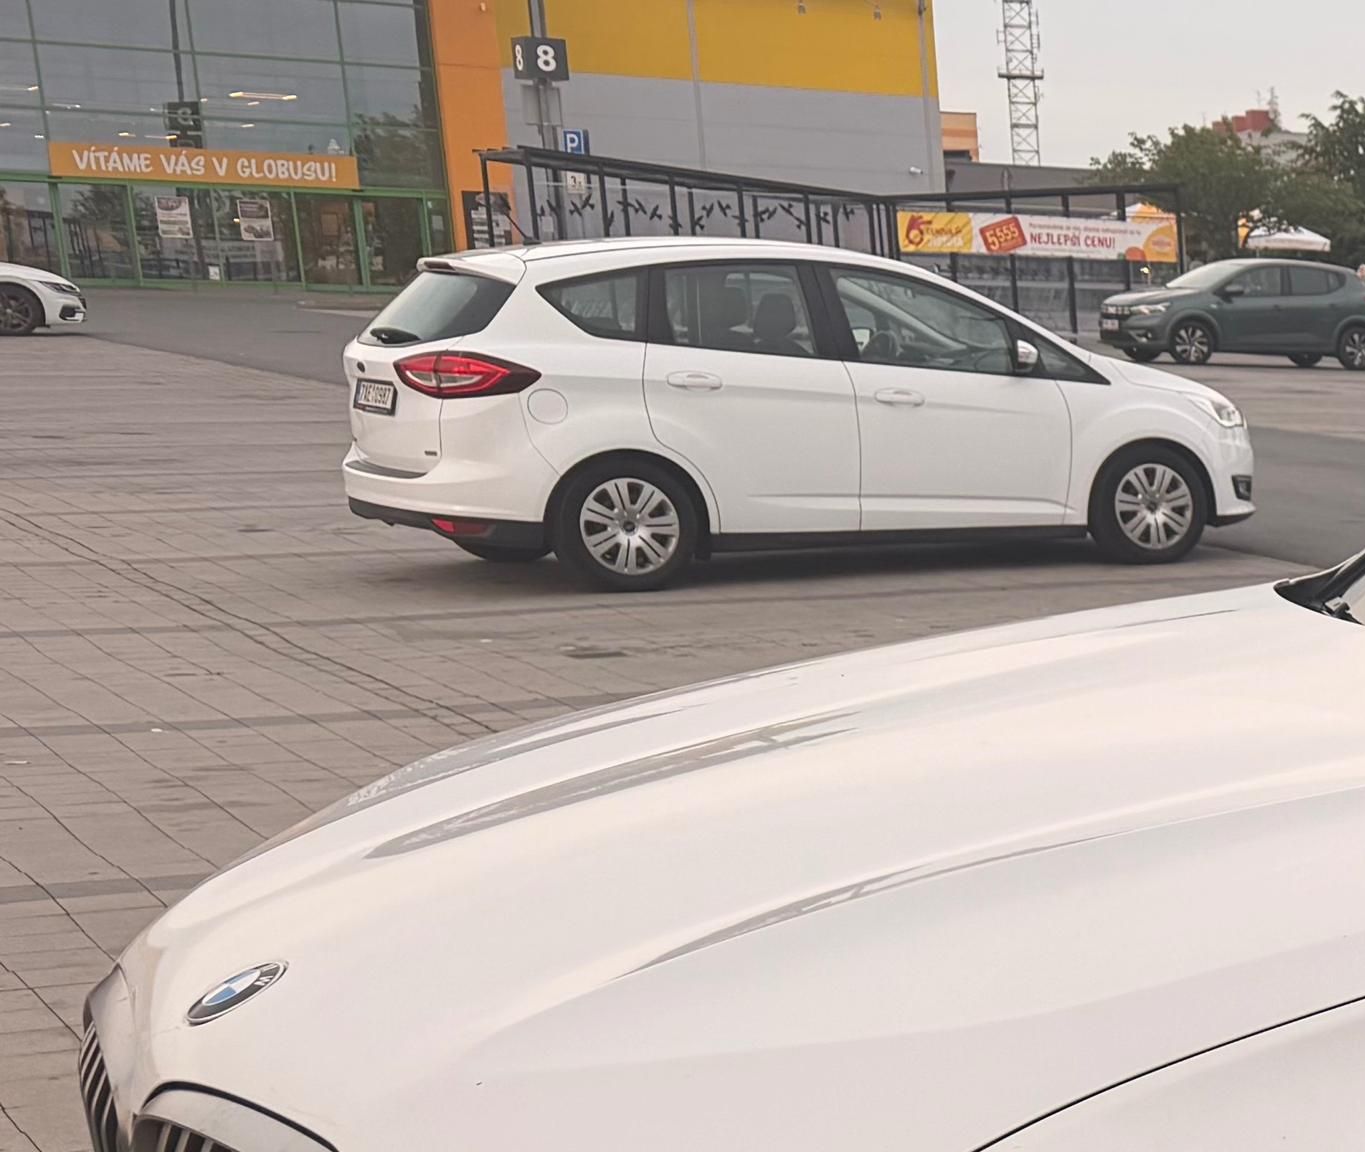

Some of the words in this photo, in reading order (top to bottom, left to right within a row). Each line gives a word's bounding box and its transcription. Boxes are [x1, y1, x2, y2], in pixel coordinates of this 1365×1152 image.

[514, 44, 524, 71] 8
[536, 44, 557, 72] 8
[566, 133, 579, 152] P
[72, 146, 153, 172] VÍTÁME
[160, 150, 205, 176] VÁS
[212, 156, 228, 177] V
[236, 157, 337, 182] GLOBUSU!
[985, 223, 1019, 250] 5555
[1030, 232, 1081, 247] NEJLEPŠÍ
[1084, 235, 1116, 249] CENU!
